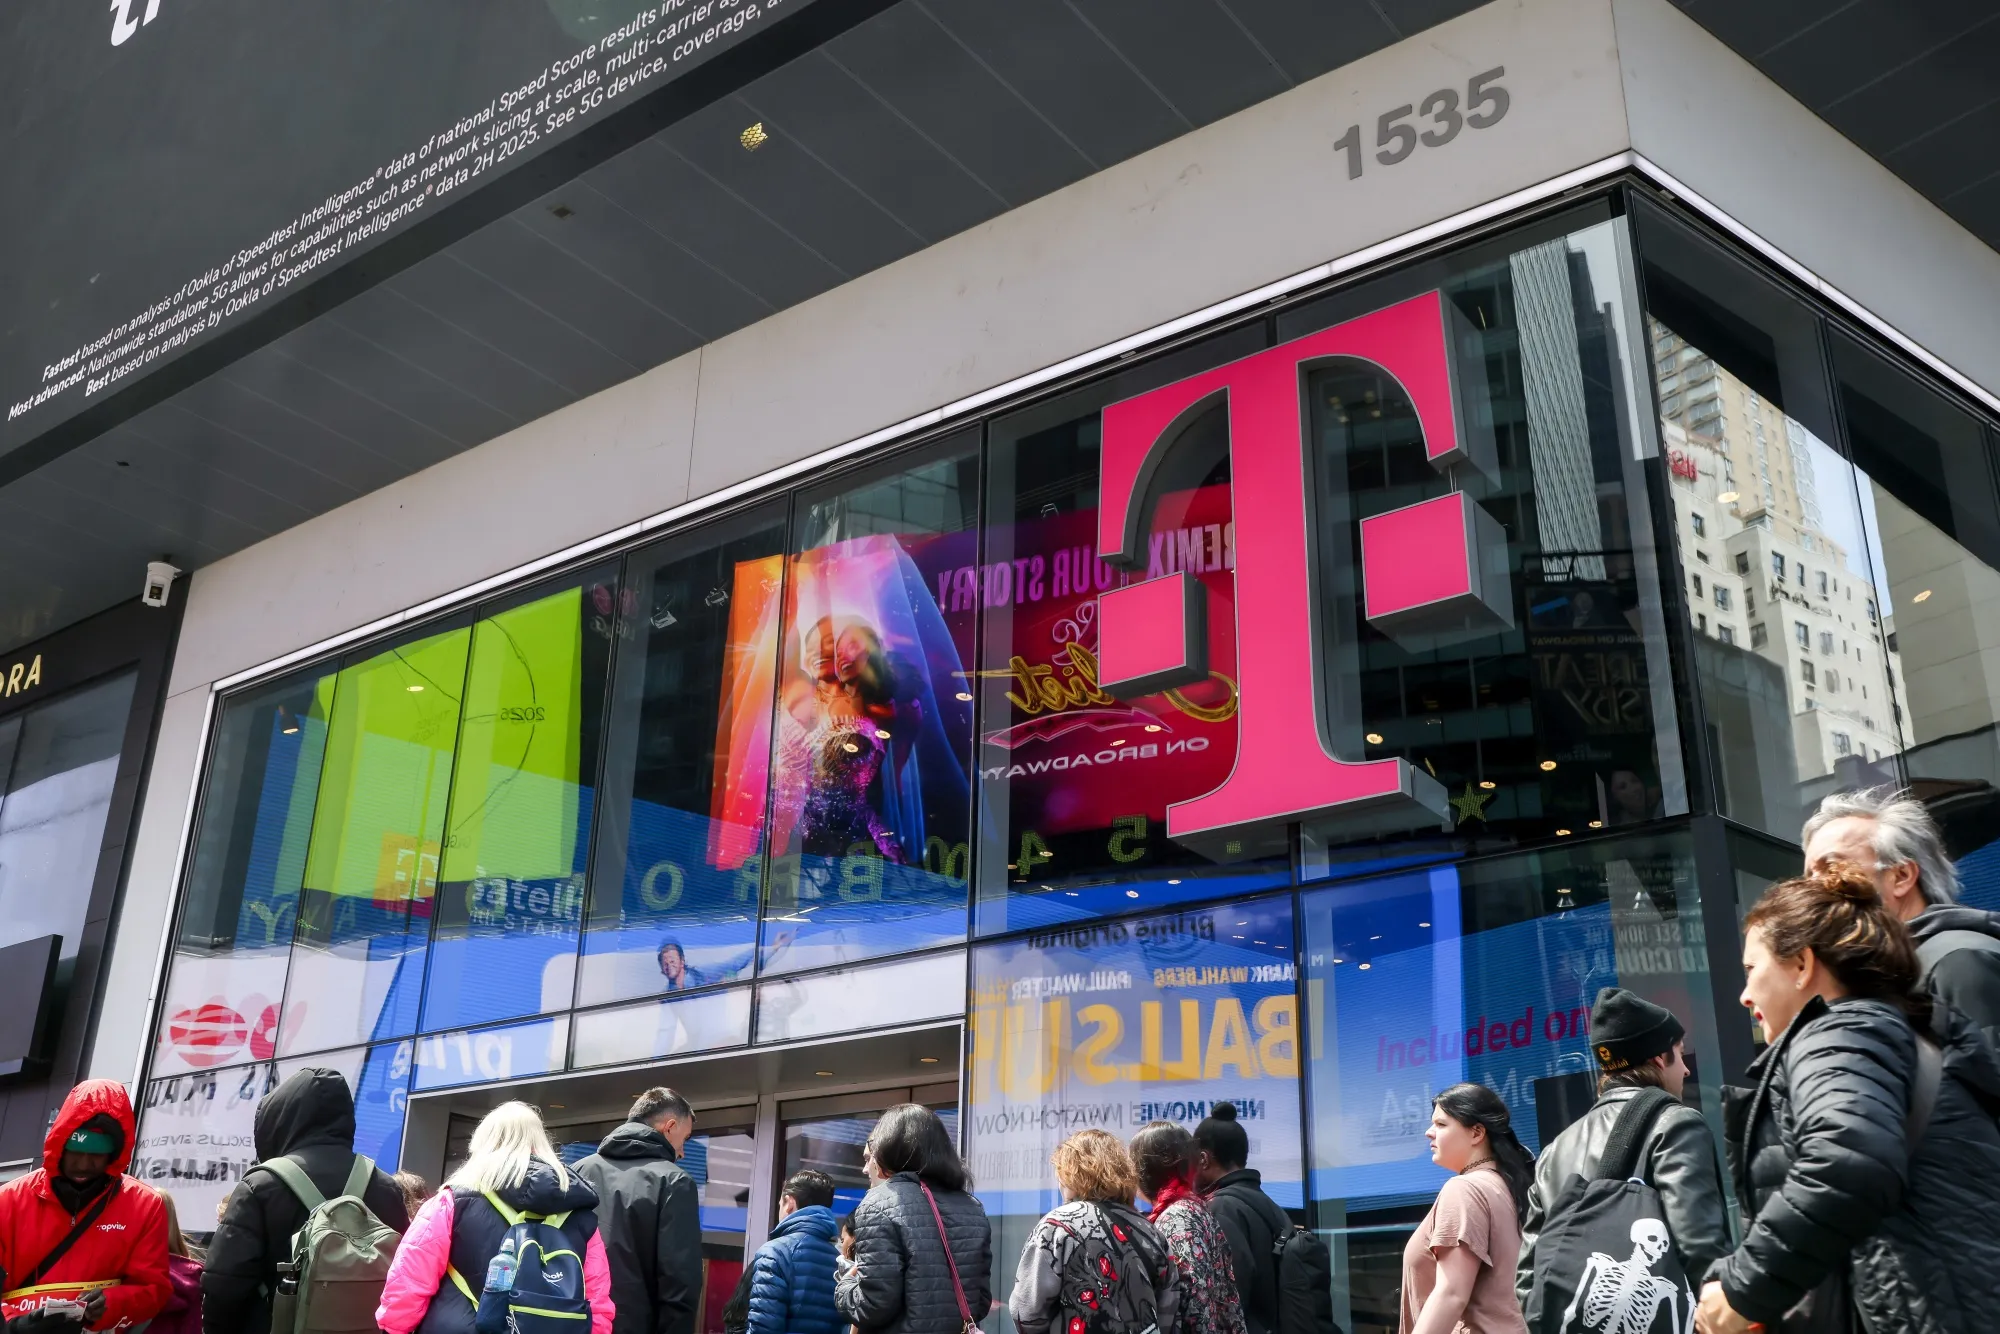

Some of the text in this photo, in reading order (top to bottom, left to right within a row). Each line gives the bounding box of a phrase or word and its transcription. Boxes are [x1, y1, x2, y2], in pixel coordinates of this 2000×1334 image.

[8, 0, 715, 422] Most advanced: Nationwide standalone 5G allows for capabilities such as network slicing at scale, multi-carrier
[42, 348, 81, 383] Fastest
[81, 327, 114, 360] based
[114, 323, 127, 341] on
[128, 295, 172, 332] analysis
[173, 283, 188, 305] of
[187, 267, 220, 297] Ookla
[222, 254, 237, 277] of
[236, 219, 299, 270] Speedtest
[384, 149, 416, 180] data
[418, 134, 436, 160] of
[436, 99, 496, 150] national
[498, 67, 548, 112] Speed
[550, 44, 597, 82] Score
[600, 8, 657, 53] results
[85, 368, 110, 398] Best
[110, 352, 144, 383] based
[145, 346, 160, 362] on
[161, 315, 206, 355] analysis
[208, 307, 224, 329] by
[225, 285, 260, 314] Ookla
[262, 273, 277, 295] of
[278, 236, 344, 285] Speedtest
[435, 167, 469, 197] data
[472, 147, 495, 177] 2H
[496, 123, 541, 163] 2025.
[545, 106, 576, 134] See
[579, 86, 604, 115] 5G
[607, 56, 668, 100] device,
[672, 3, 762, 63] coverage,
[1333, 65, 1510, 181] 1535
[0, 654, 42, 698] RA
[1376, 1006, 1534, 1074] Included
